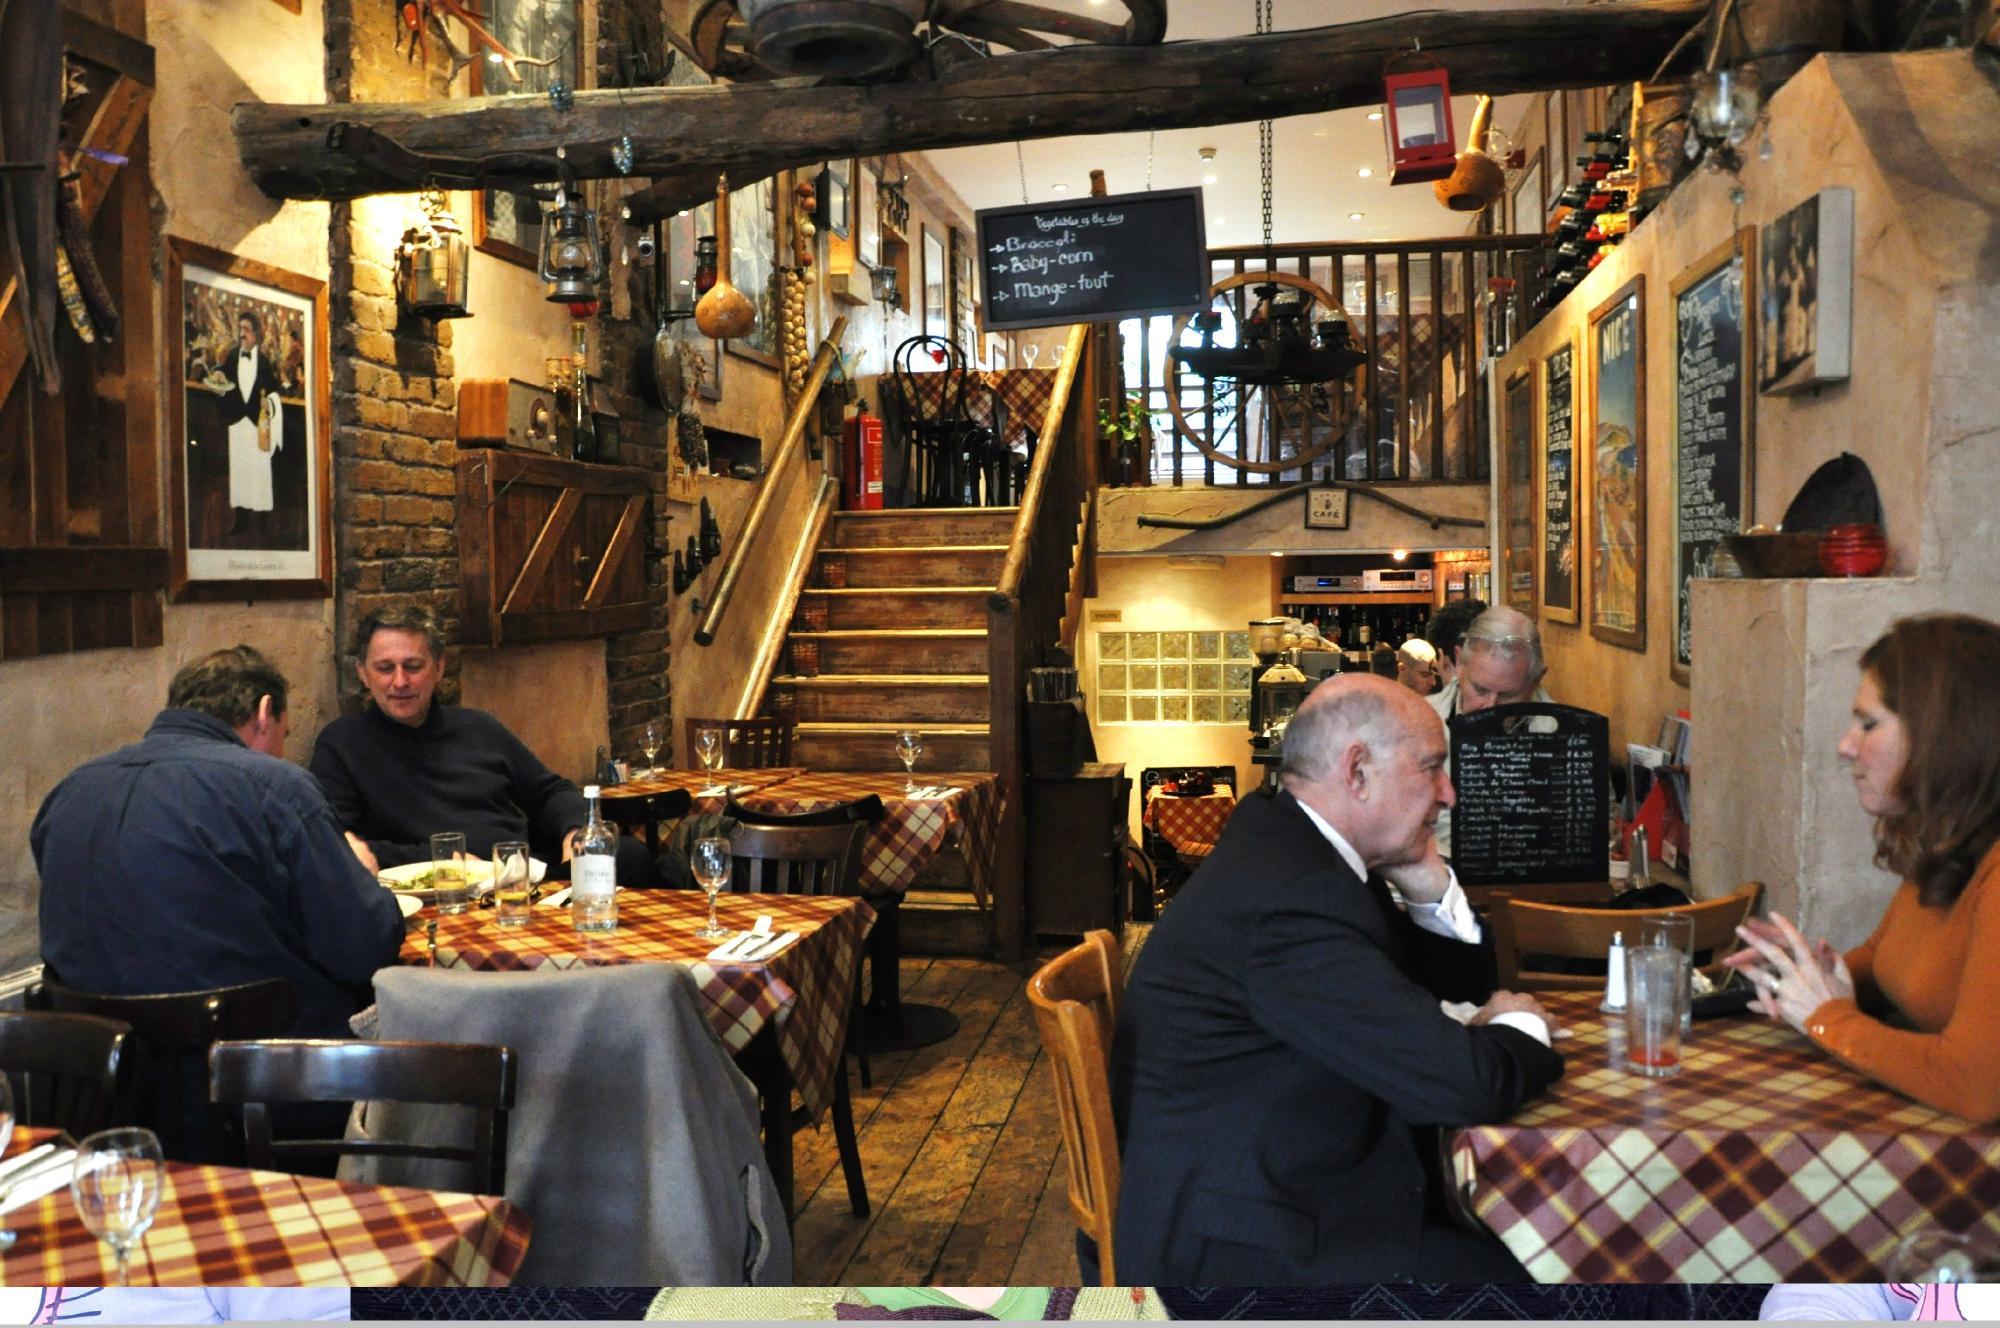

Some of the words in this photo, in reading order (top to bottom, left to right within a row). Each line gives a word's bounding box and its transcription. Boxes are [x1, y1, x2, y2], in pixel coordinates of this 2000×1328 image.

[1034, 216, 1079, 232] Vegetables
[1092, 213, 1105, 223] the
[1106, 212, 1124, 226] day
[1010, 250, 1094, 275] Baby-corn
[1313, 509, 1340, 518] CAFÉ
